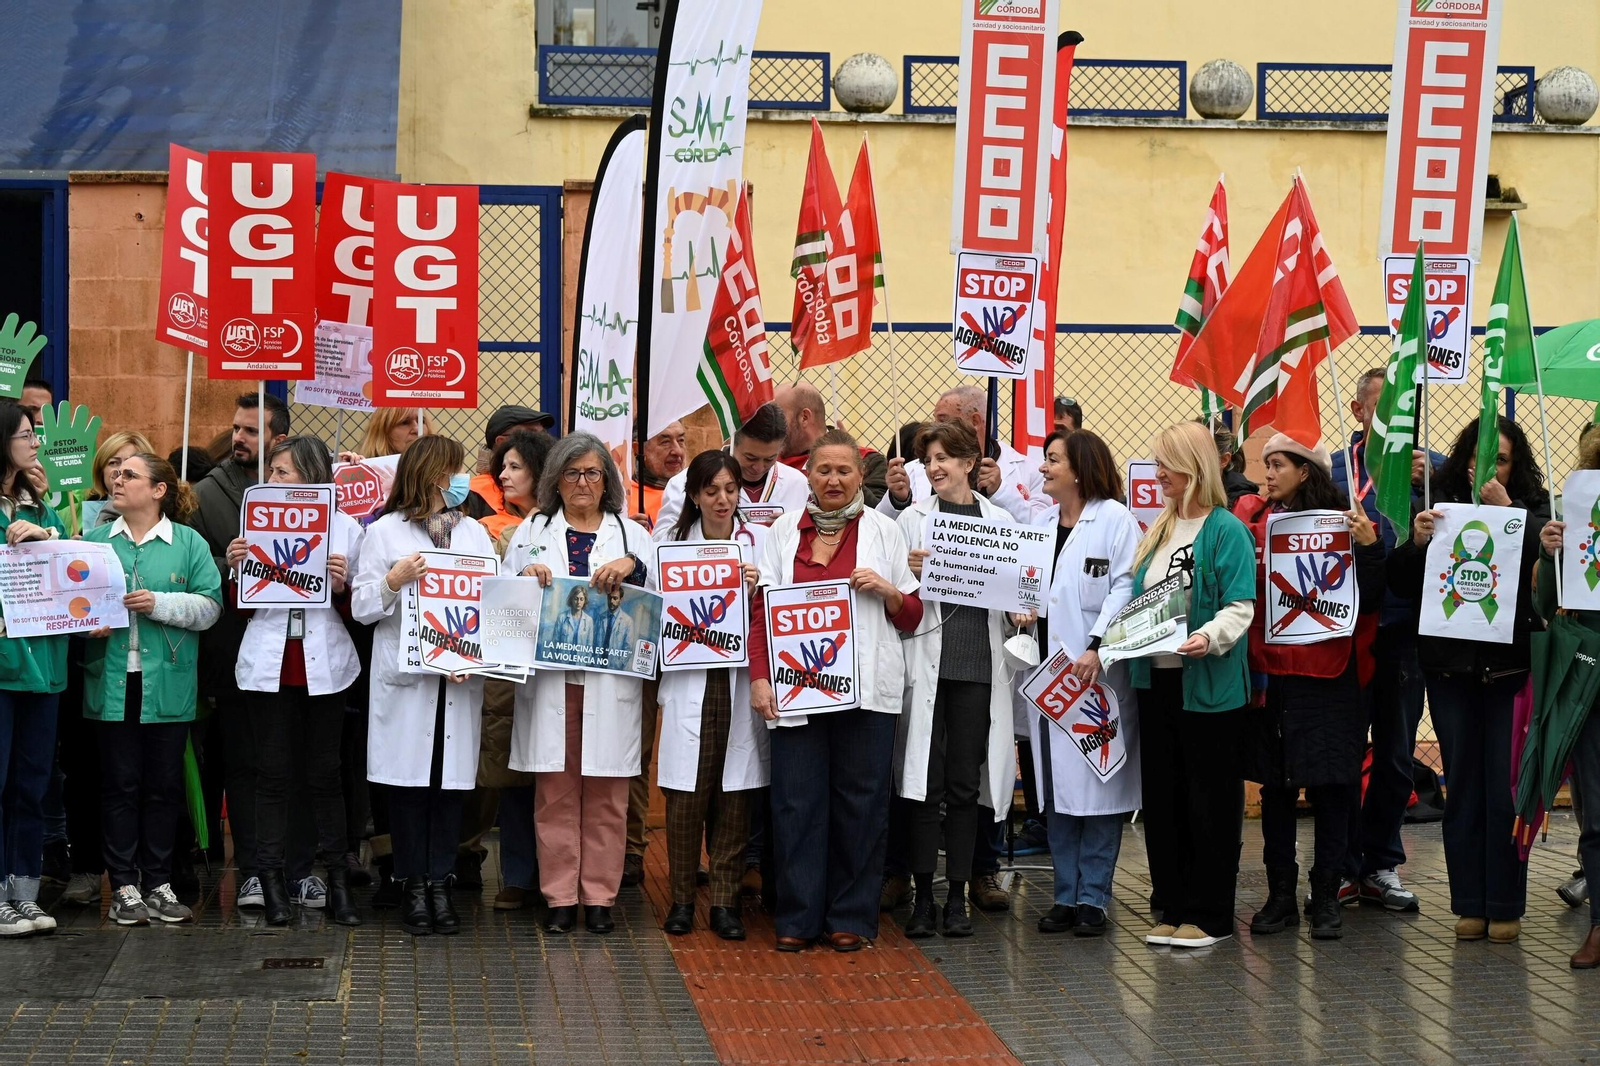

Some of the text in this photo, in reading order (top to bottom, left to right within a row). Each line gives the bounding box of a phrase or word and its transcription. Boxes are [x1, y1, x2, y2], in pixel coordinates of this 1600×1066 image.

[996, 4, 1039, 15] CÓRDOBA
[1435, 0, 1481, 11] CÓRDOBA
[1002, 23, 1046, 32] sociosanitario
[1441, 20, 1488, 28] sociosanitario
[976, 43, 1029, 241] CCOO
[1408, 41, 1470, 243] CCOO
[229, 162, 294, 314] UGT
[394, 195, 457, 343] UGT
[964, 273, 1026, 298] STOP
[1392, 278, 1458, 301] SOP
[172, 297, 196, 316] UGT
[199, 307, 208, 319] FS
[982, 306, 1018, 338] NO
[1427, 310, 1449, 343] O
[225, 325, 286, 342] UGT FSP
[1, 347, 16, 355] TOP
[723, 315, 755, 394] Córdoba
[955, 326, 1026, 365] AGRESIONES
[0, 355, 26, 365] SIONES
[390, 353, 449, 369] UGT FSP
[0, 366, 16, 374] UIDA
[579, 348, 632, 403] SMA
[333, 390, 361, 398] PROBLEMA
[44, 445, 89, 456] AGRESIONES
[53, 439, 77, 447] #STOP
[60, 476, 82, 485] SATSE
[340, 470, 365, 482] SAS
[335, 480, 375, 502] STOP
[1136, 483, 1163, 505] ST
[338, 497, 375, 508] AGRESIONES
[252, 506, 320, 529] STOP
[933, 518, 1050, 542] LA MEDICINA ES “ARTE”
[931, 531, 1019, 552] LA VIOLENCIA NO
[1288, 533, 1334, 551] STOP
[273, 537, 311, 569] NO
[931, 544, 968, 557] “Cuidar
[982, 553, 994, 561] un
[996, 555, 1018, 564] acto
[667, 563, 732, 588] STOP
[929, 557, 998, 575] de humanidad.
[1294, 551, 1346, 599] NO
[1460, 569, 1488, 582] STOP
[241, 559, 324, 593] AGRESIONES
[424, 573, 482, 598] STOP
[928, 571, 985, 587] Agredir, una
[1021, 577, 1040, 585] STOP
[1456, 580, 1491, 588] AGRESIONES
[926, 585, 983, 599] vergüenza.”
[1018, 590, 1036, 602] SMA
[485, 609, 537, 618] LA MEDICINA
[690, 595, 727, 629] NO
[1278, 591, 1350, 619] AGRESIONES
[40, 613, 69, 622] PROBLEMA
[46, 617, 100, 631] RESPÉTAME
[444, 605, 480, 638] NO
[485, 619, 495, 627] ES
[777, 605, 841, 632] STOP
[420, 625, 483, 659] AGRESION
[486, 629, 496, 637] LA
[662, 621, 742, 652] AGRESIONES
[542, 651, 609, 666] LA VIOLENCIA NO
[544, 640, 555, 650] LA
[556, 642, 594, 654] MEDICINA
[595, 647, 604, 655] ES
[605, 648, 632, 659] “ARTE”
[800, 638, 838, 673] NO
[1575, 652, 1596, 666] Córdob
[775, 666, 852, 694] AGRESIONES
[1043, 673, 1082, 714] STO
[1080, 692, 1111, 731] NO
